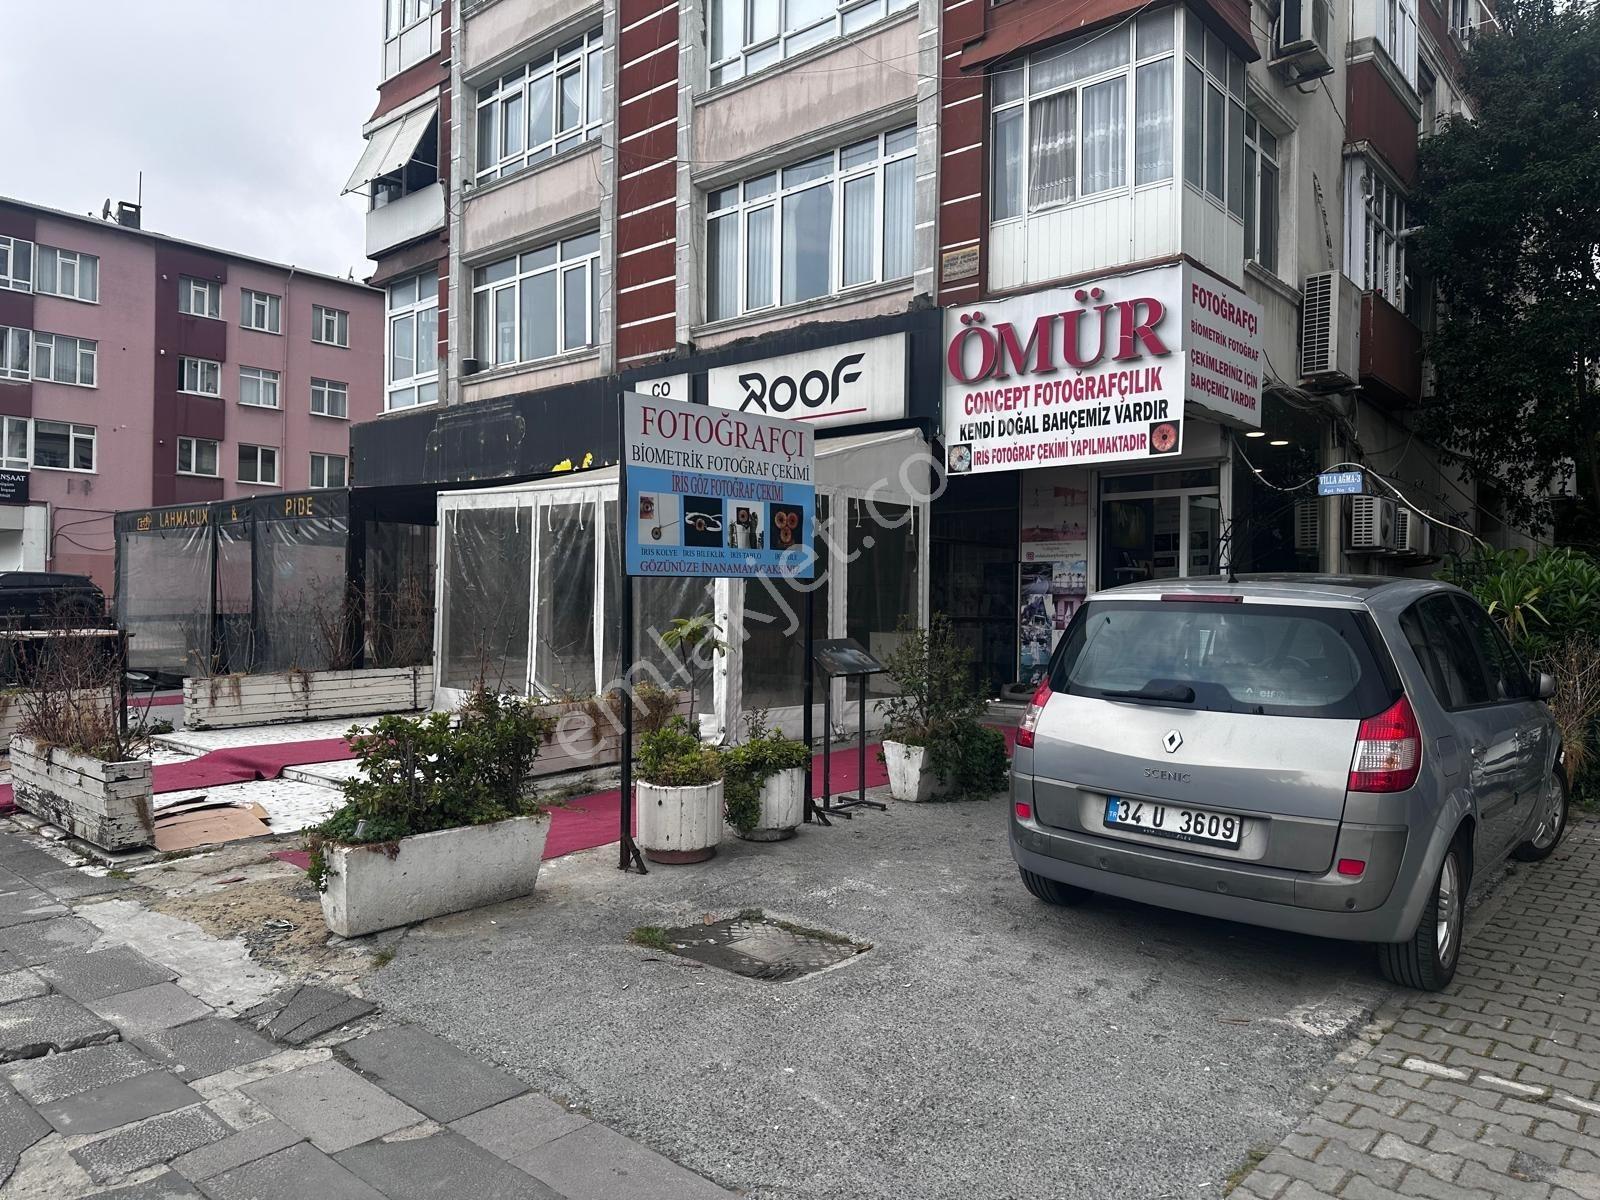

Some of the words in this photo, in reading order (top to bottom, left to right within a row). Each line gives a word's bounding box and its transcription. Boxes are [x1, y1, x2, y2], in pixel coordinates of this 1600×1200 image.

[1191, 282, 1258, 338] FOTOĞRAFÇI
[947, 287, 1171, 384] ÖMÜR
[1190, 318, 1227, 347] BİOMETRİK
[1228, 337, 1259, 362] FOTOĞRAF
[738, 352, 866, 414] ROOF
[1190, 348, 1243, 383] ÇEKİMLERİNİZ
[1243, 368, 1258, 390] İÇİN
[965, 385, 1031, 415] CONCEPT
[1034, 366, 1163, 407] FOTOĞRAFÇILIK
[1190, 371, 1229, 400] BAHÇEMİZ
[1230, 387, 1256, 411] VARDIR
[640, 405, 805, 462] FOTOĞRAFÇI
[960, 415, 995, 442] KENDİ
[998, 411, 1040, 438] DOĞAL
[1042, 401, 1111, 434] BAHÇEMİZ
[1115, 399, 1169, 422] VARDIR
[632, 442, 704, 470] BİOMETRİK
[707, 455, 769, 477] FOTOĞRAF
[771, 463, 811, 482] ÇEKİMİ
[973, 445, 990, 466] İRİS
[992, 441, 1036, 463] FOTOĞRAF
[1038, 436, 1069, 465] ÇEKİMİ
[1070, 432, 1147, 458] YAPILMAKTADIR
[690, 474, 709, 495] GÖZ
[710, 477, 754, 499] FOTOĞRAF
[756, 482, 784, 502] ÇEKİMİ
[1143, 767, 1192, 784] SCENIC
[1109, 810, 1117, 818] TR
[1118, 800, 1144, 825] 34
[1152, 806, 1165, 828] U
[1179, 811, 1235, 840] 3609
